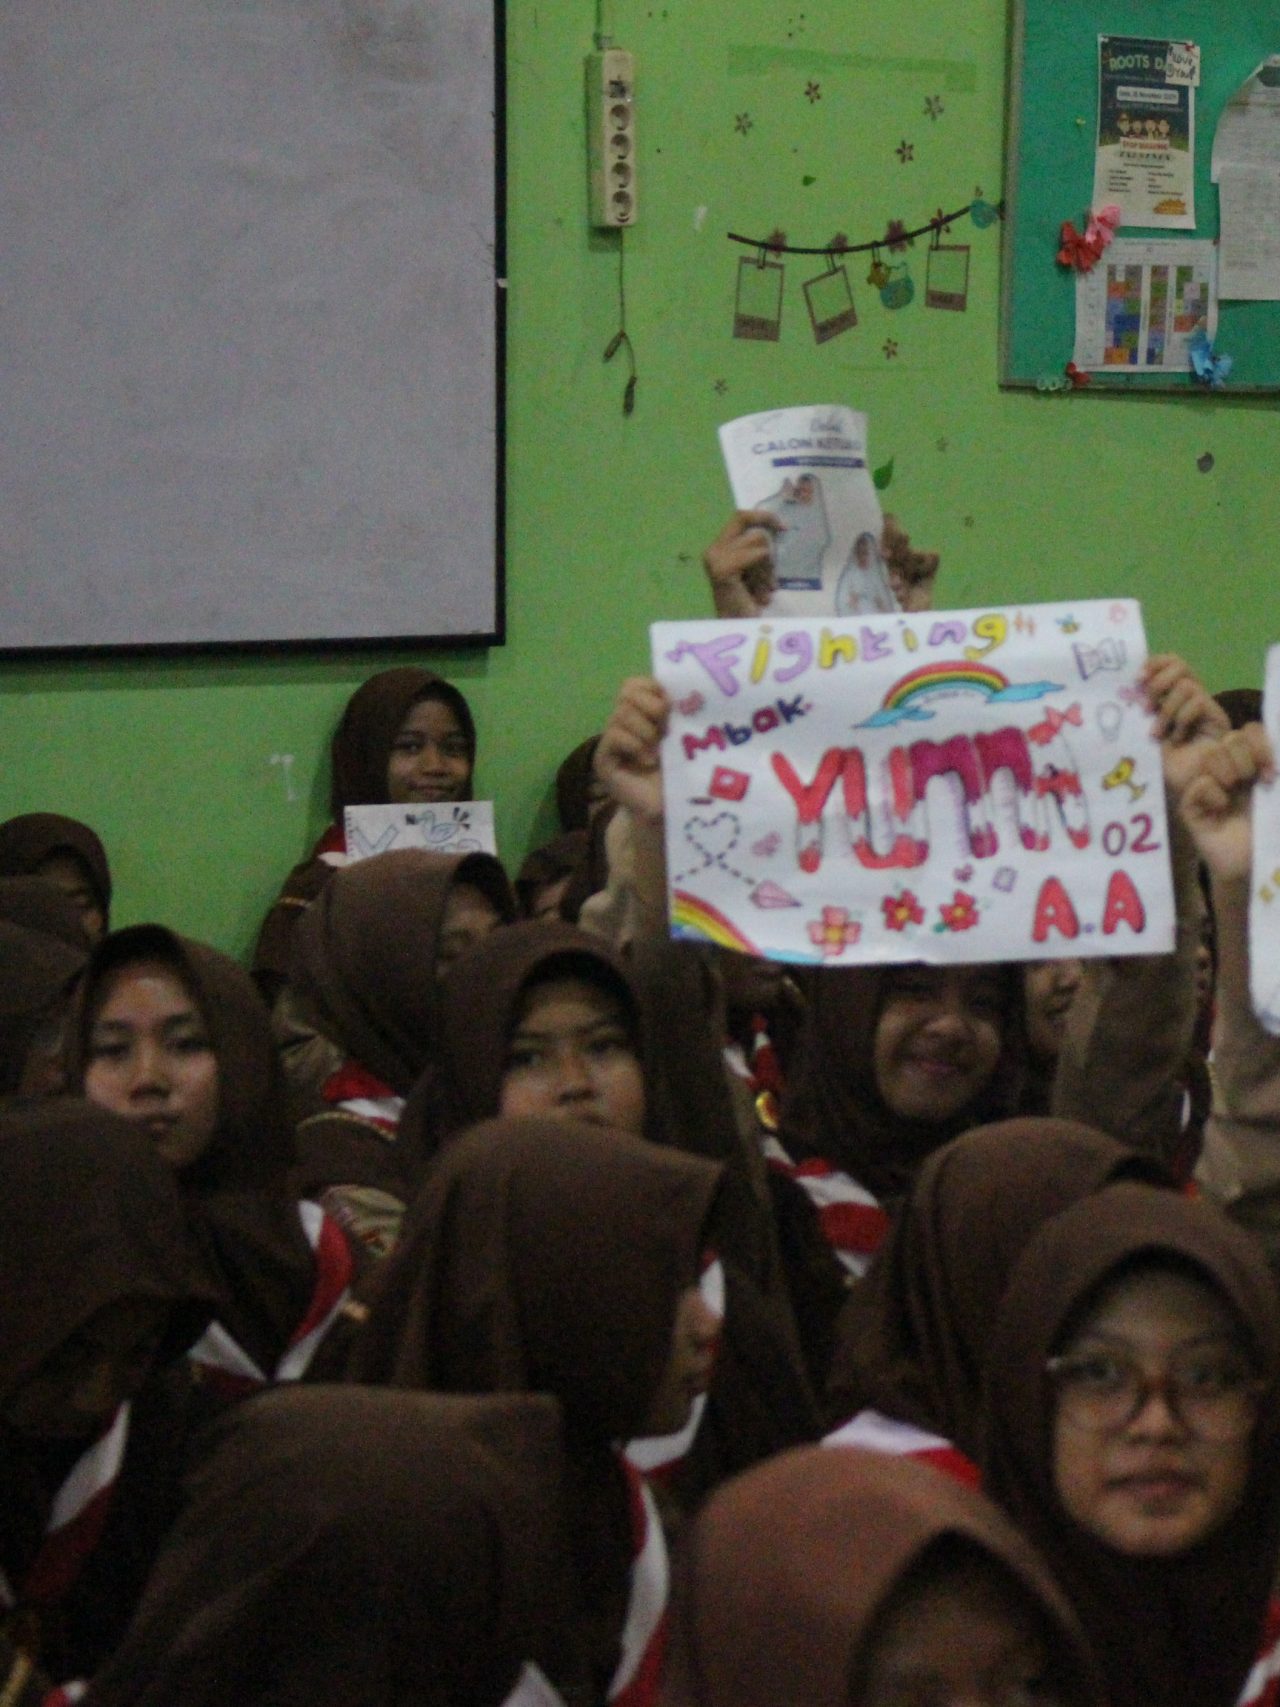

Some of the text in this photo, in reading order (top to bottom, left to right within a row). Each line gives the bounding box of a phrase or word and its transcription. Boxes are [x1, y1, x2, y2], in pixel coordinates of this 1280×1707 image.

[1109, 53, 1151, 71] ROOTS
[752, 437, 813, 455] CALON
[1102, 812, 1162, 857] 02
